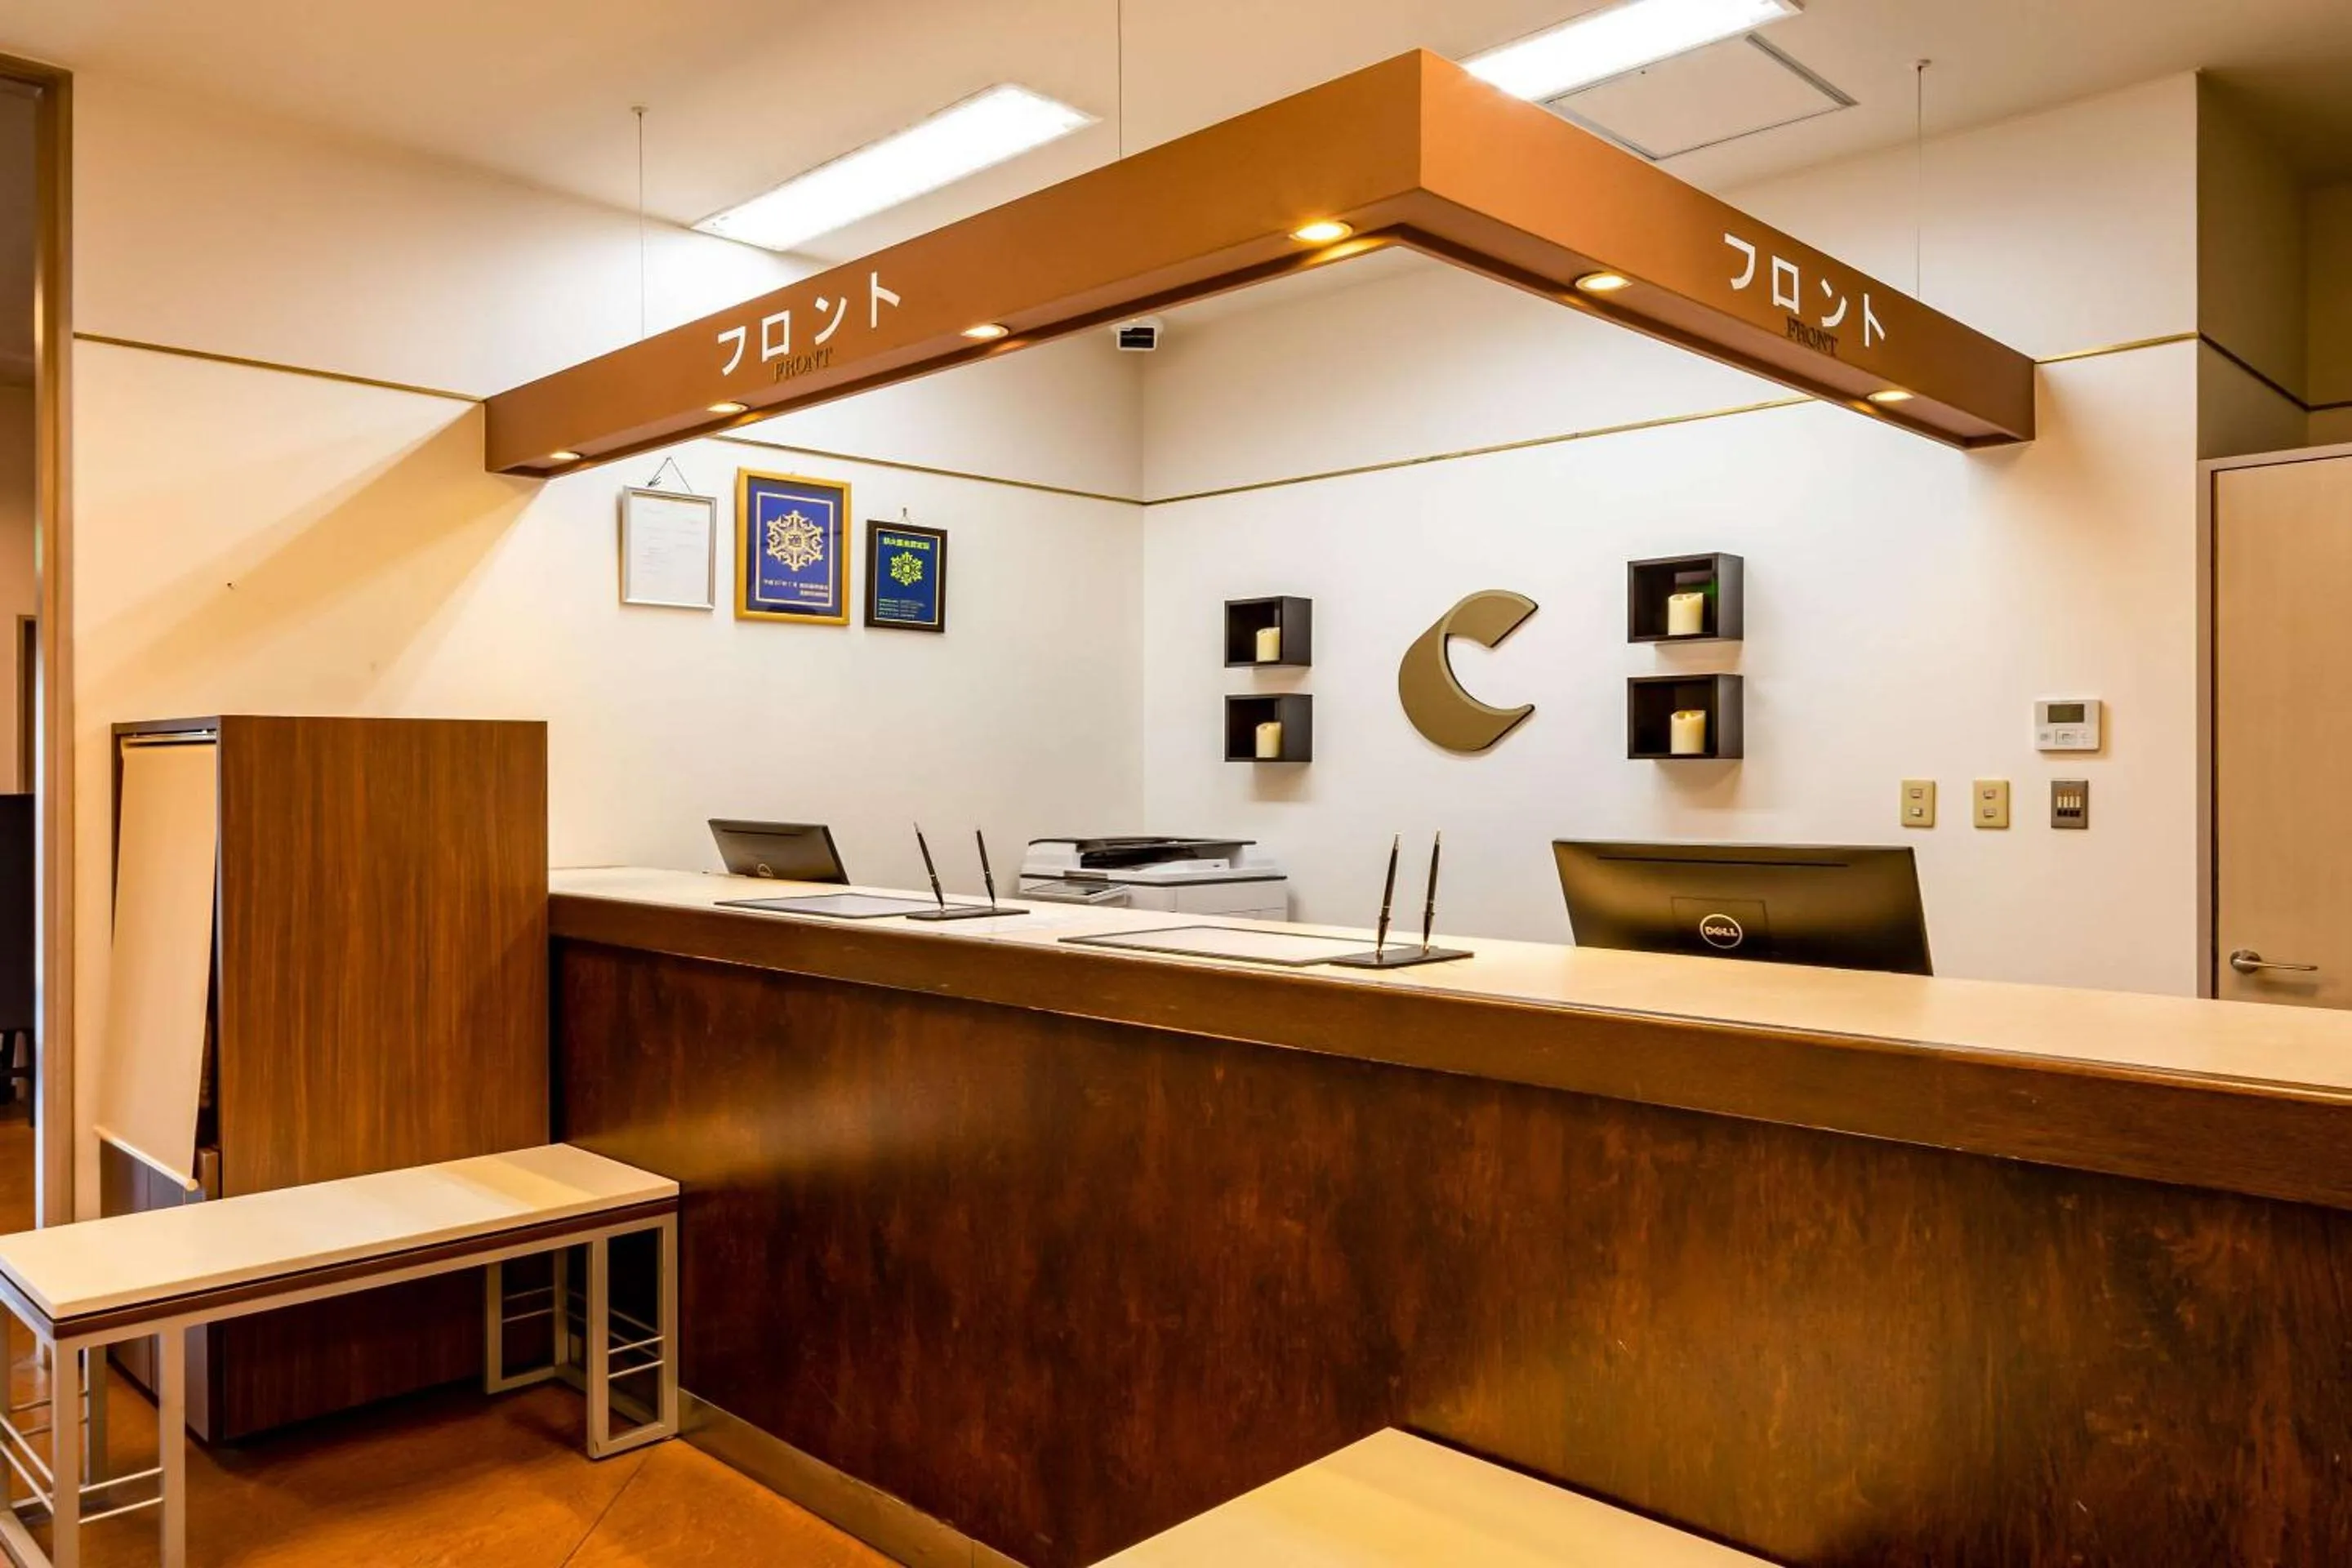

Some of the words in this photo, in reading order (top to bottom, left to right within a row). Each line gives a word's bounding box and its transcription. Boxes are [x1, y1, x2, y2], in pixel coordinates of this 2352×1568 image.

[1724, 232, 1886, 348] フロント
[717, 270, 902, 376] フロント
[1786, 315, 1838, 357] FRONT
[775, 347, 833, 382] FRONT
[1704, 925, 1739, 938] DELL
